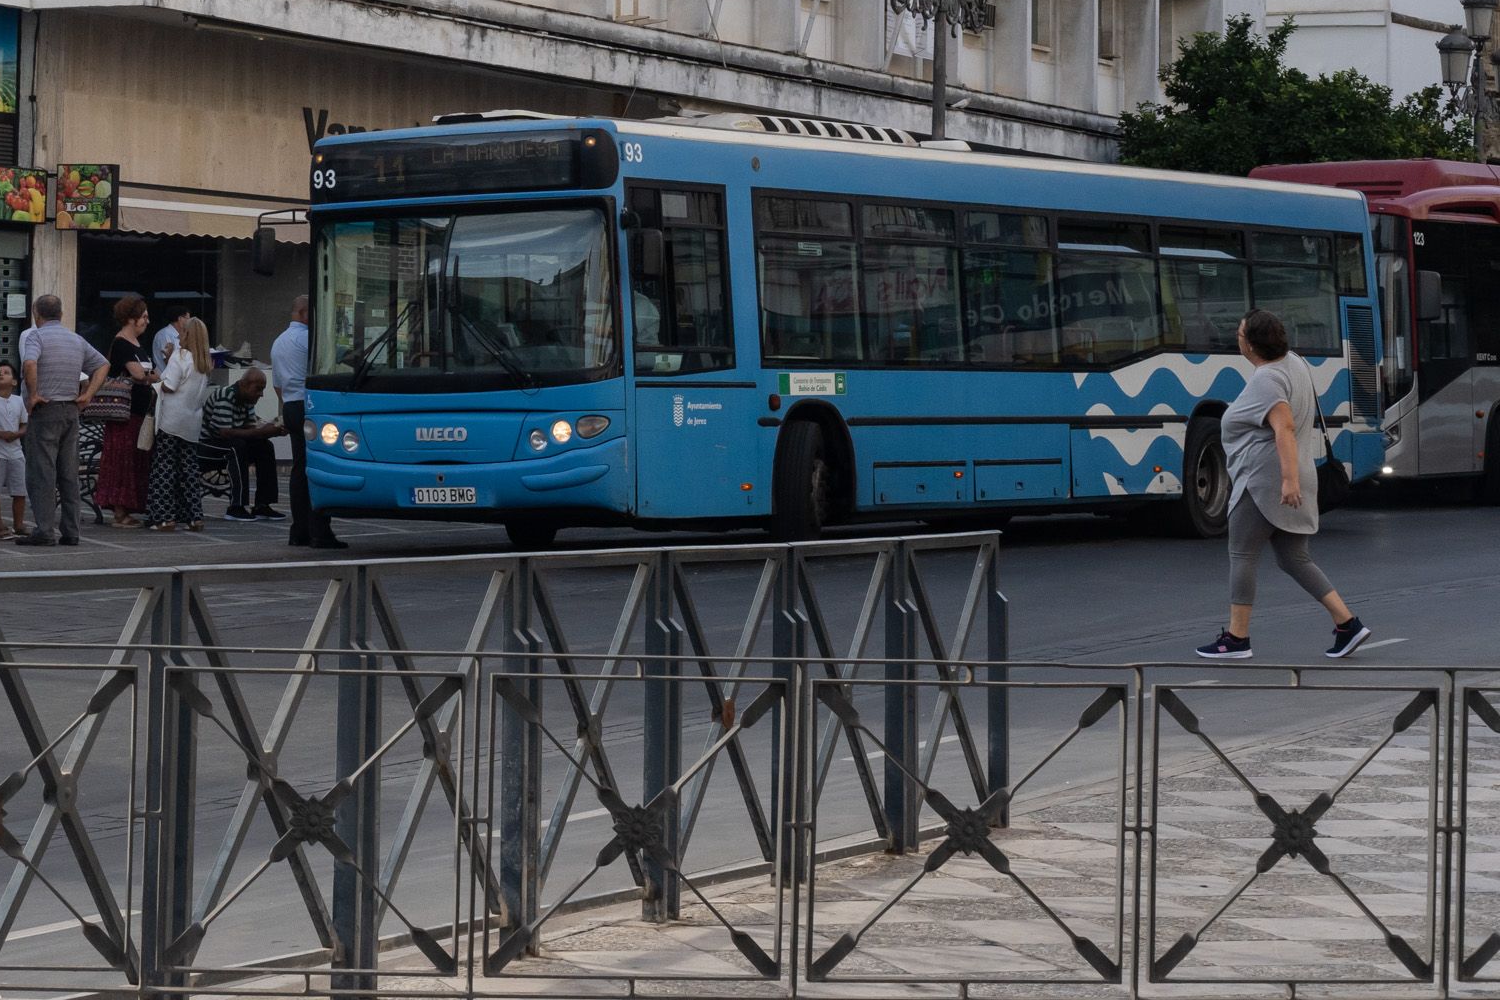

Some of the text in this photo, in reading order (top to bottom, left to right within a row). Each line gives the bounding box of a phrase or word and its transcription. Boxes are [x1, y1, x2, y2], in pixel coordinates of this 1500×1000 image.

[624, 142, 643, 163] 93
[313, 169, 337, 189] 93
[1413, 232, 1425, 246] 123
[687, 402, 722, 412] Ayuntamiento
[687, 416, 707, 426] de Jerez
[416, 427, 468, 442] IVECO
[417, 488, 474, 502] 0103 BMG
